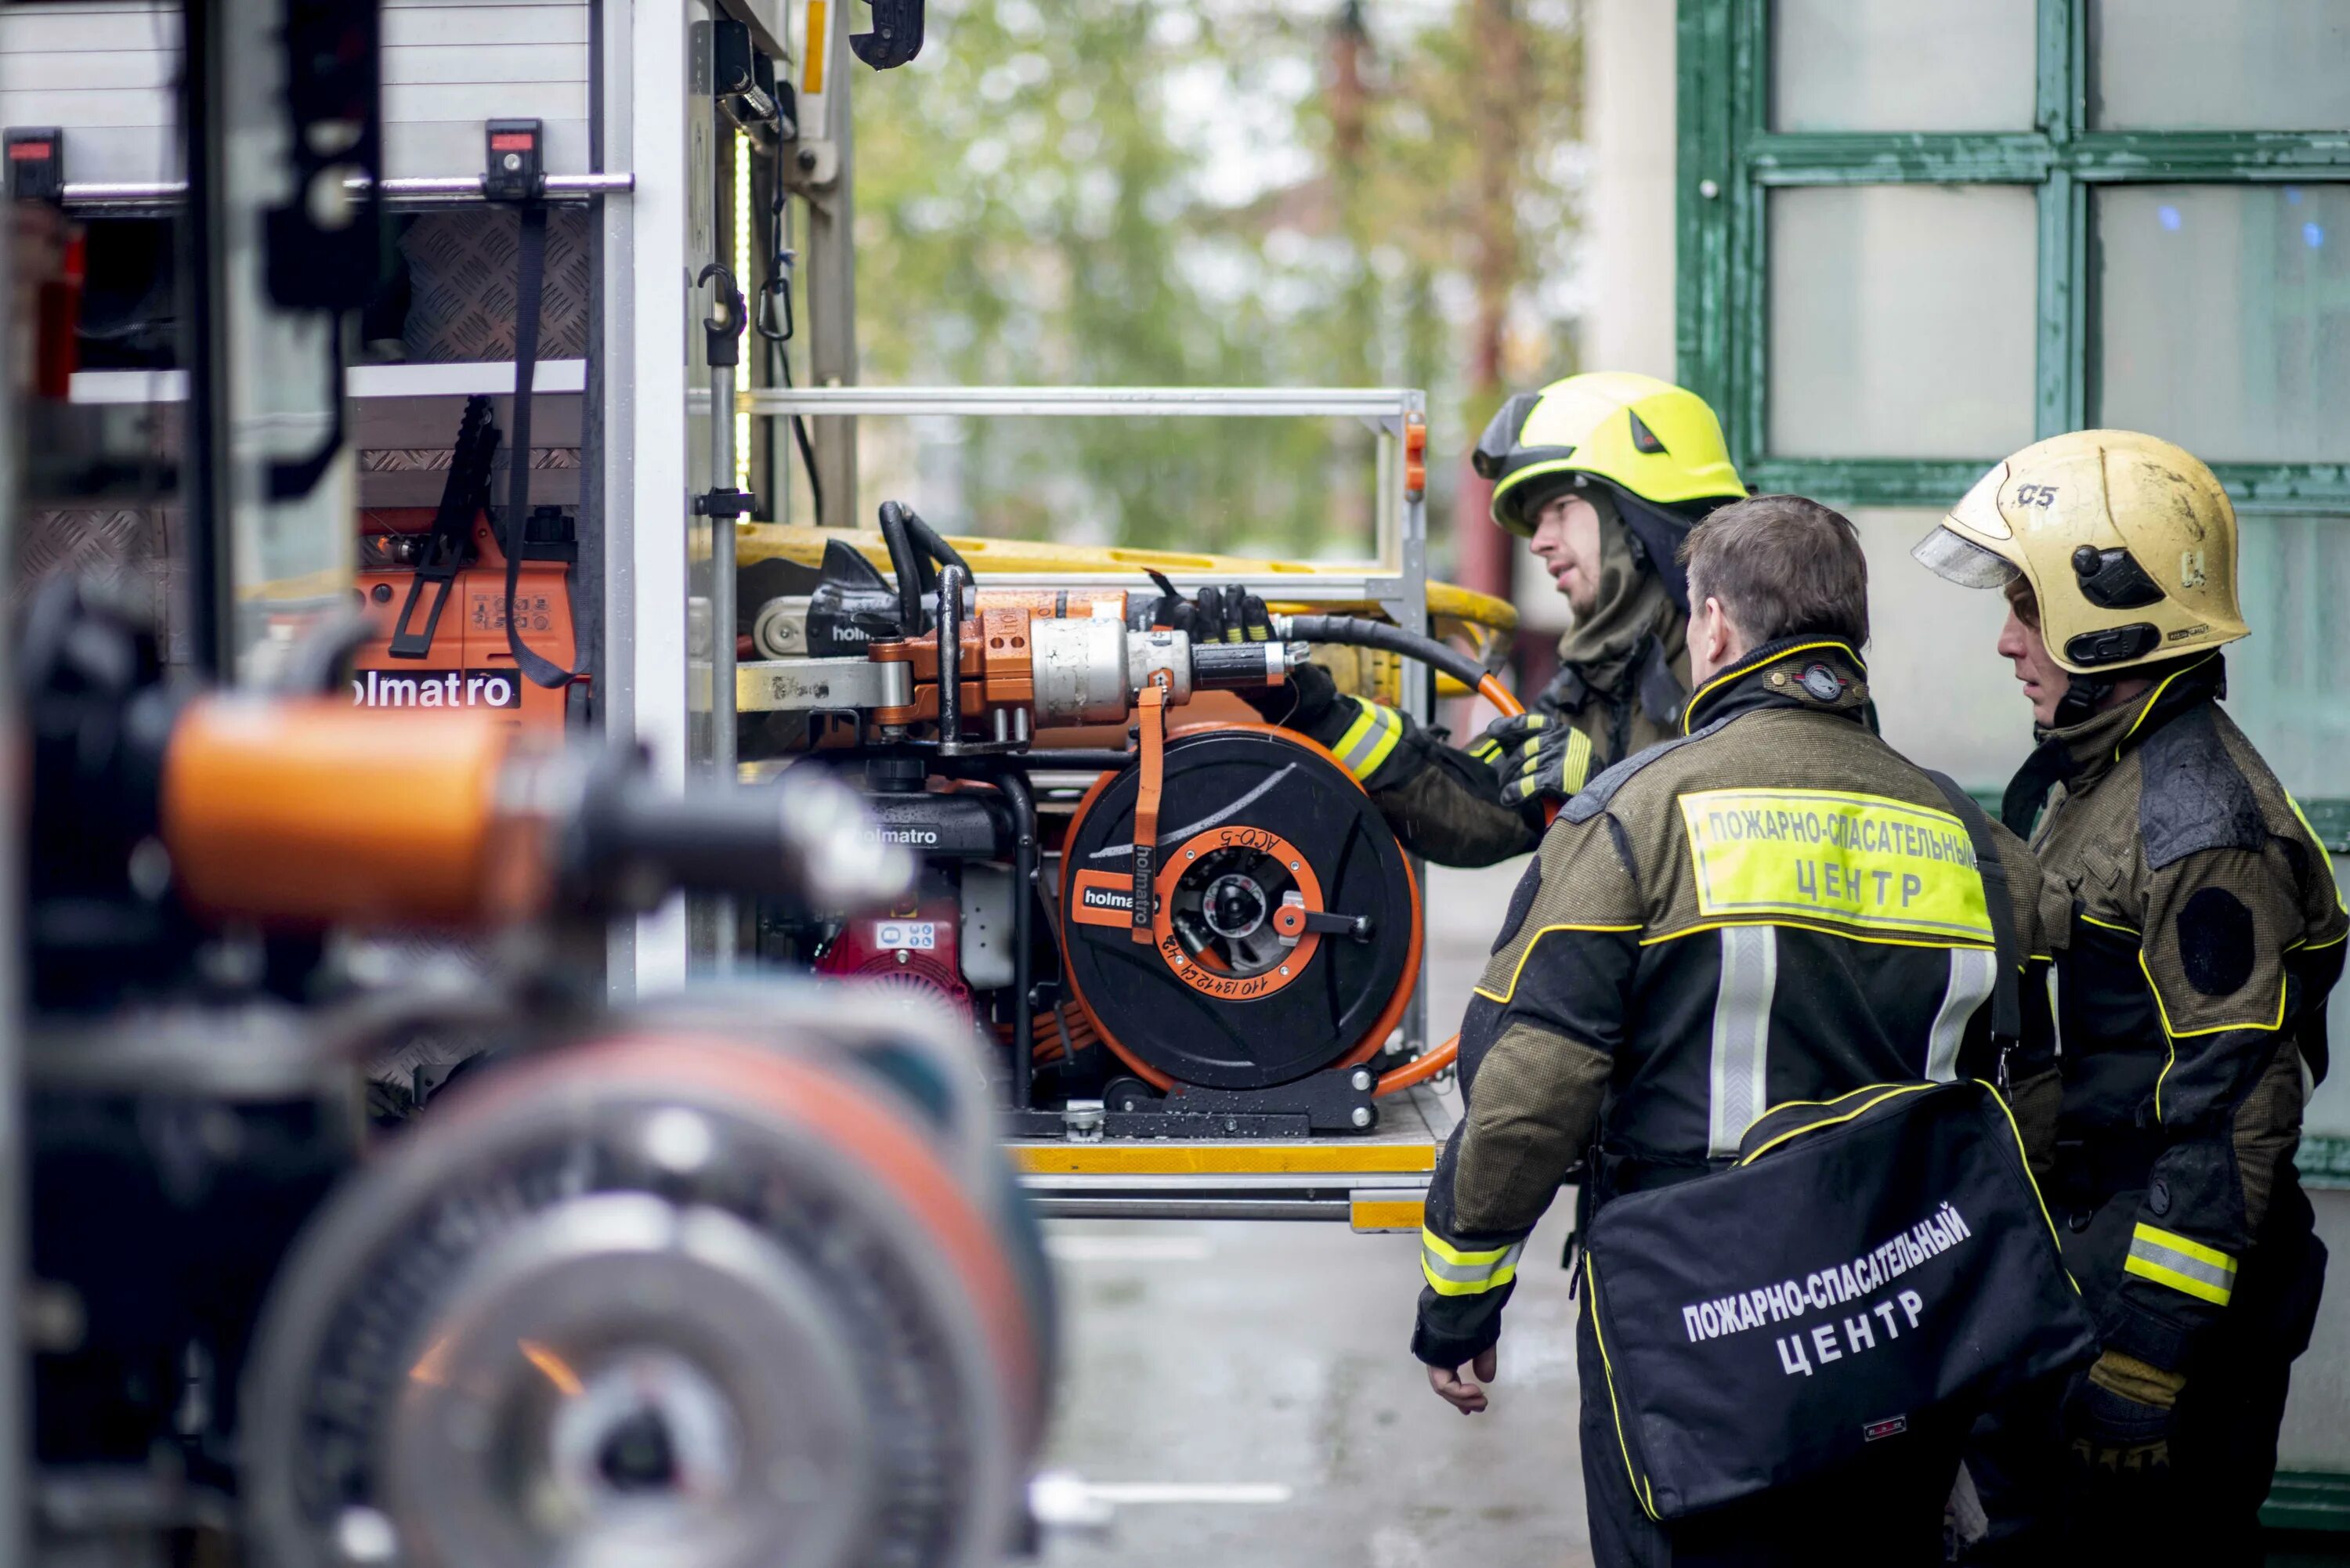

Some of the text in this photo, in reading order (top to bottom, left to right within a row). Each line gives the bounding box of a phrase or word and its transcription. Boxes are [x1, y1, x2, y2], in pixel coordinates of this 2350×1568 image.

[351, 670, 512, 706] olmatro
[863, 828, 937, 844] olmatro
[1134, 846, 1152, 924] holmatro
[1795, 858, 1922, 908] ЦЕНТР
[1683, 1201, 1972, 1342] ПОЖАРНО-СПАСАТЕЛЬНЫЙ
[1776, 1289, 1924, 1377] ЦЕНТР
